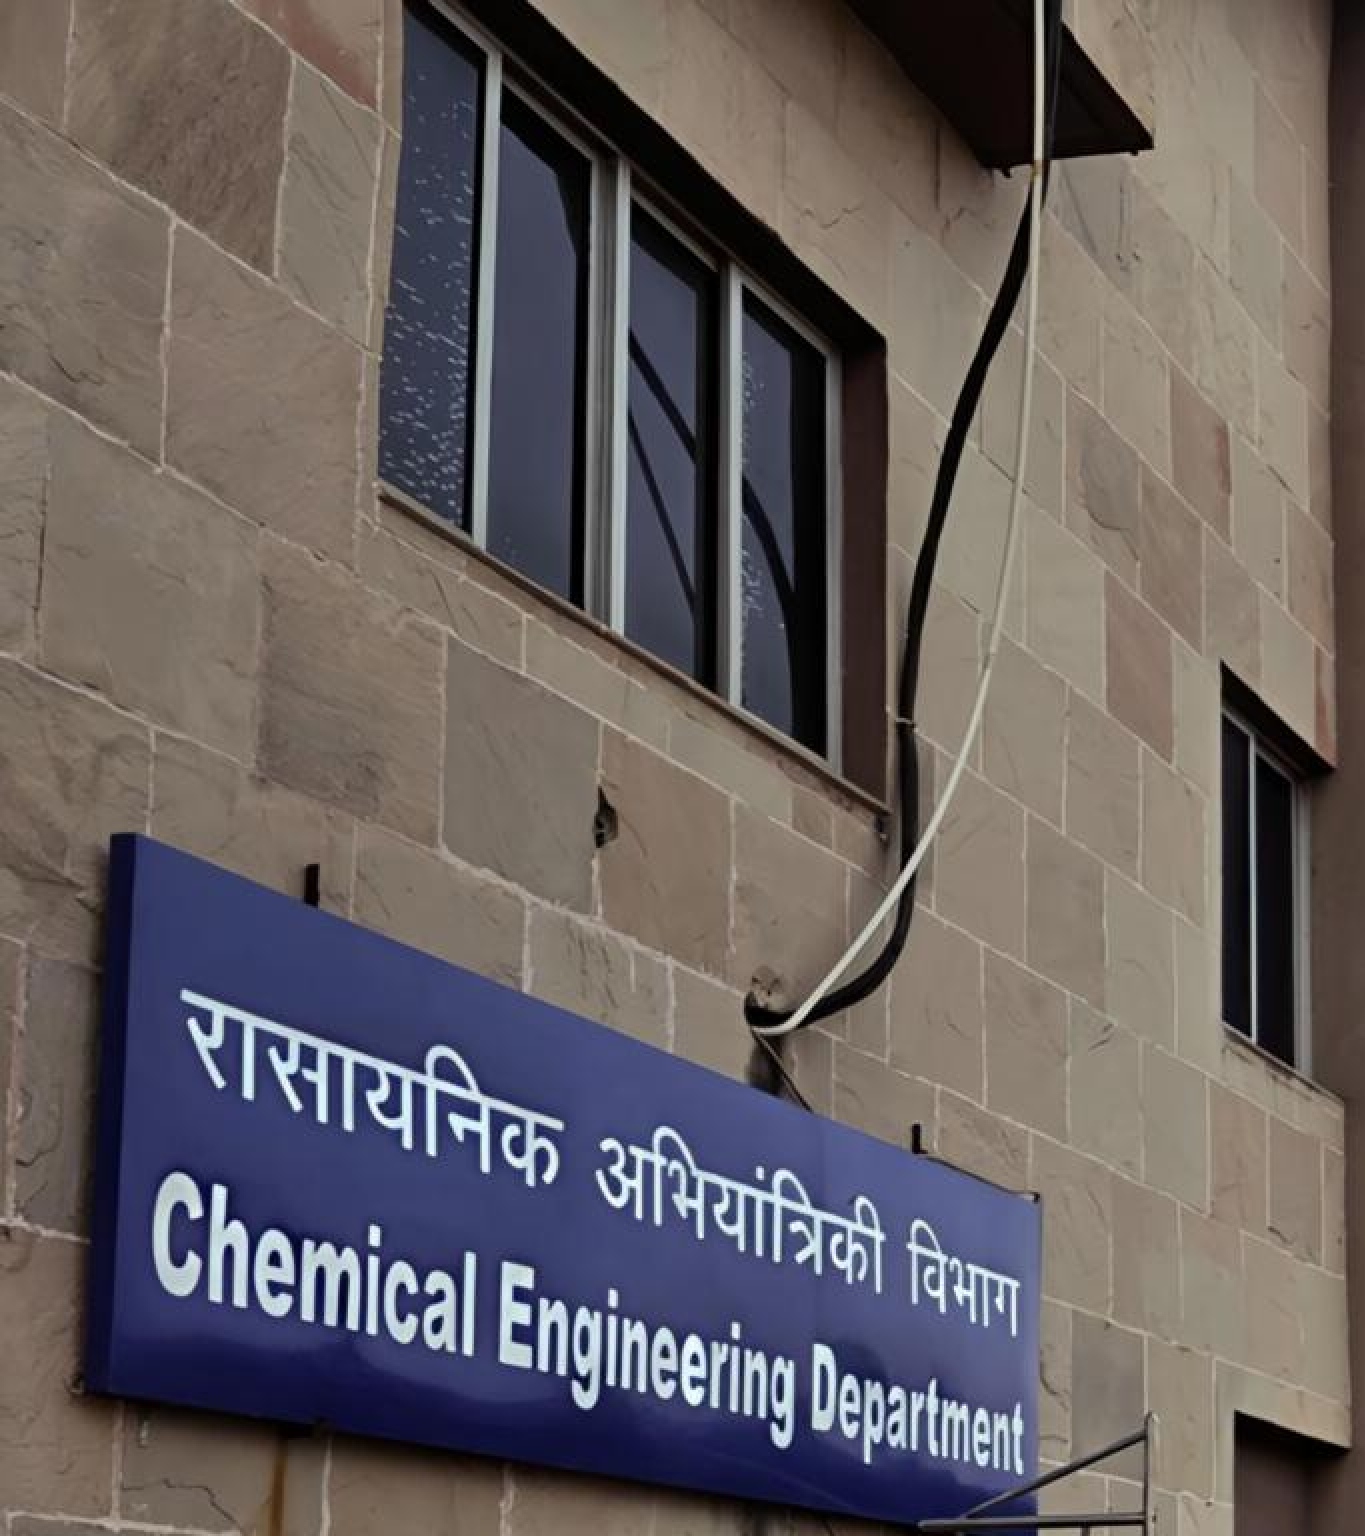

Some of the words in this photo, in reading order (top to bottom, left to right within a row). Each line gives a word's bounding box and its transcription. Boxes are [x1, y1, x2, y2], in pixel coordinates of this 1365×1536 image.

[152, 1171, 478, 1357] Chemical
[499, 1261, 795, 1449] Engineering
[811, 1343, 1025, 1475] Department
[179, 988, 565, 1187] रासायनिक
[596, 1125, 886, 1295] अभियांत्रिकी
[906, 1218, 1021, 1337] विभाग
